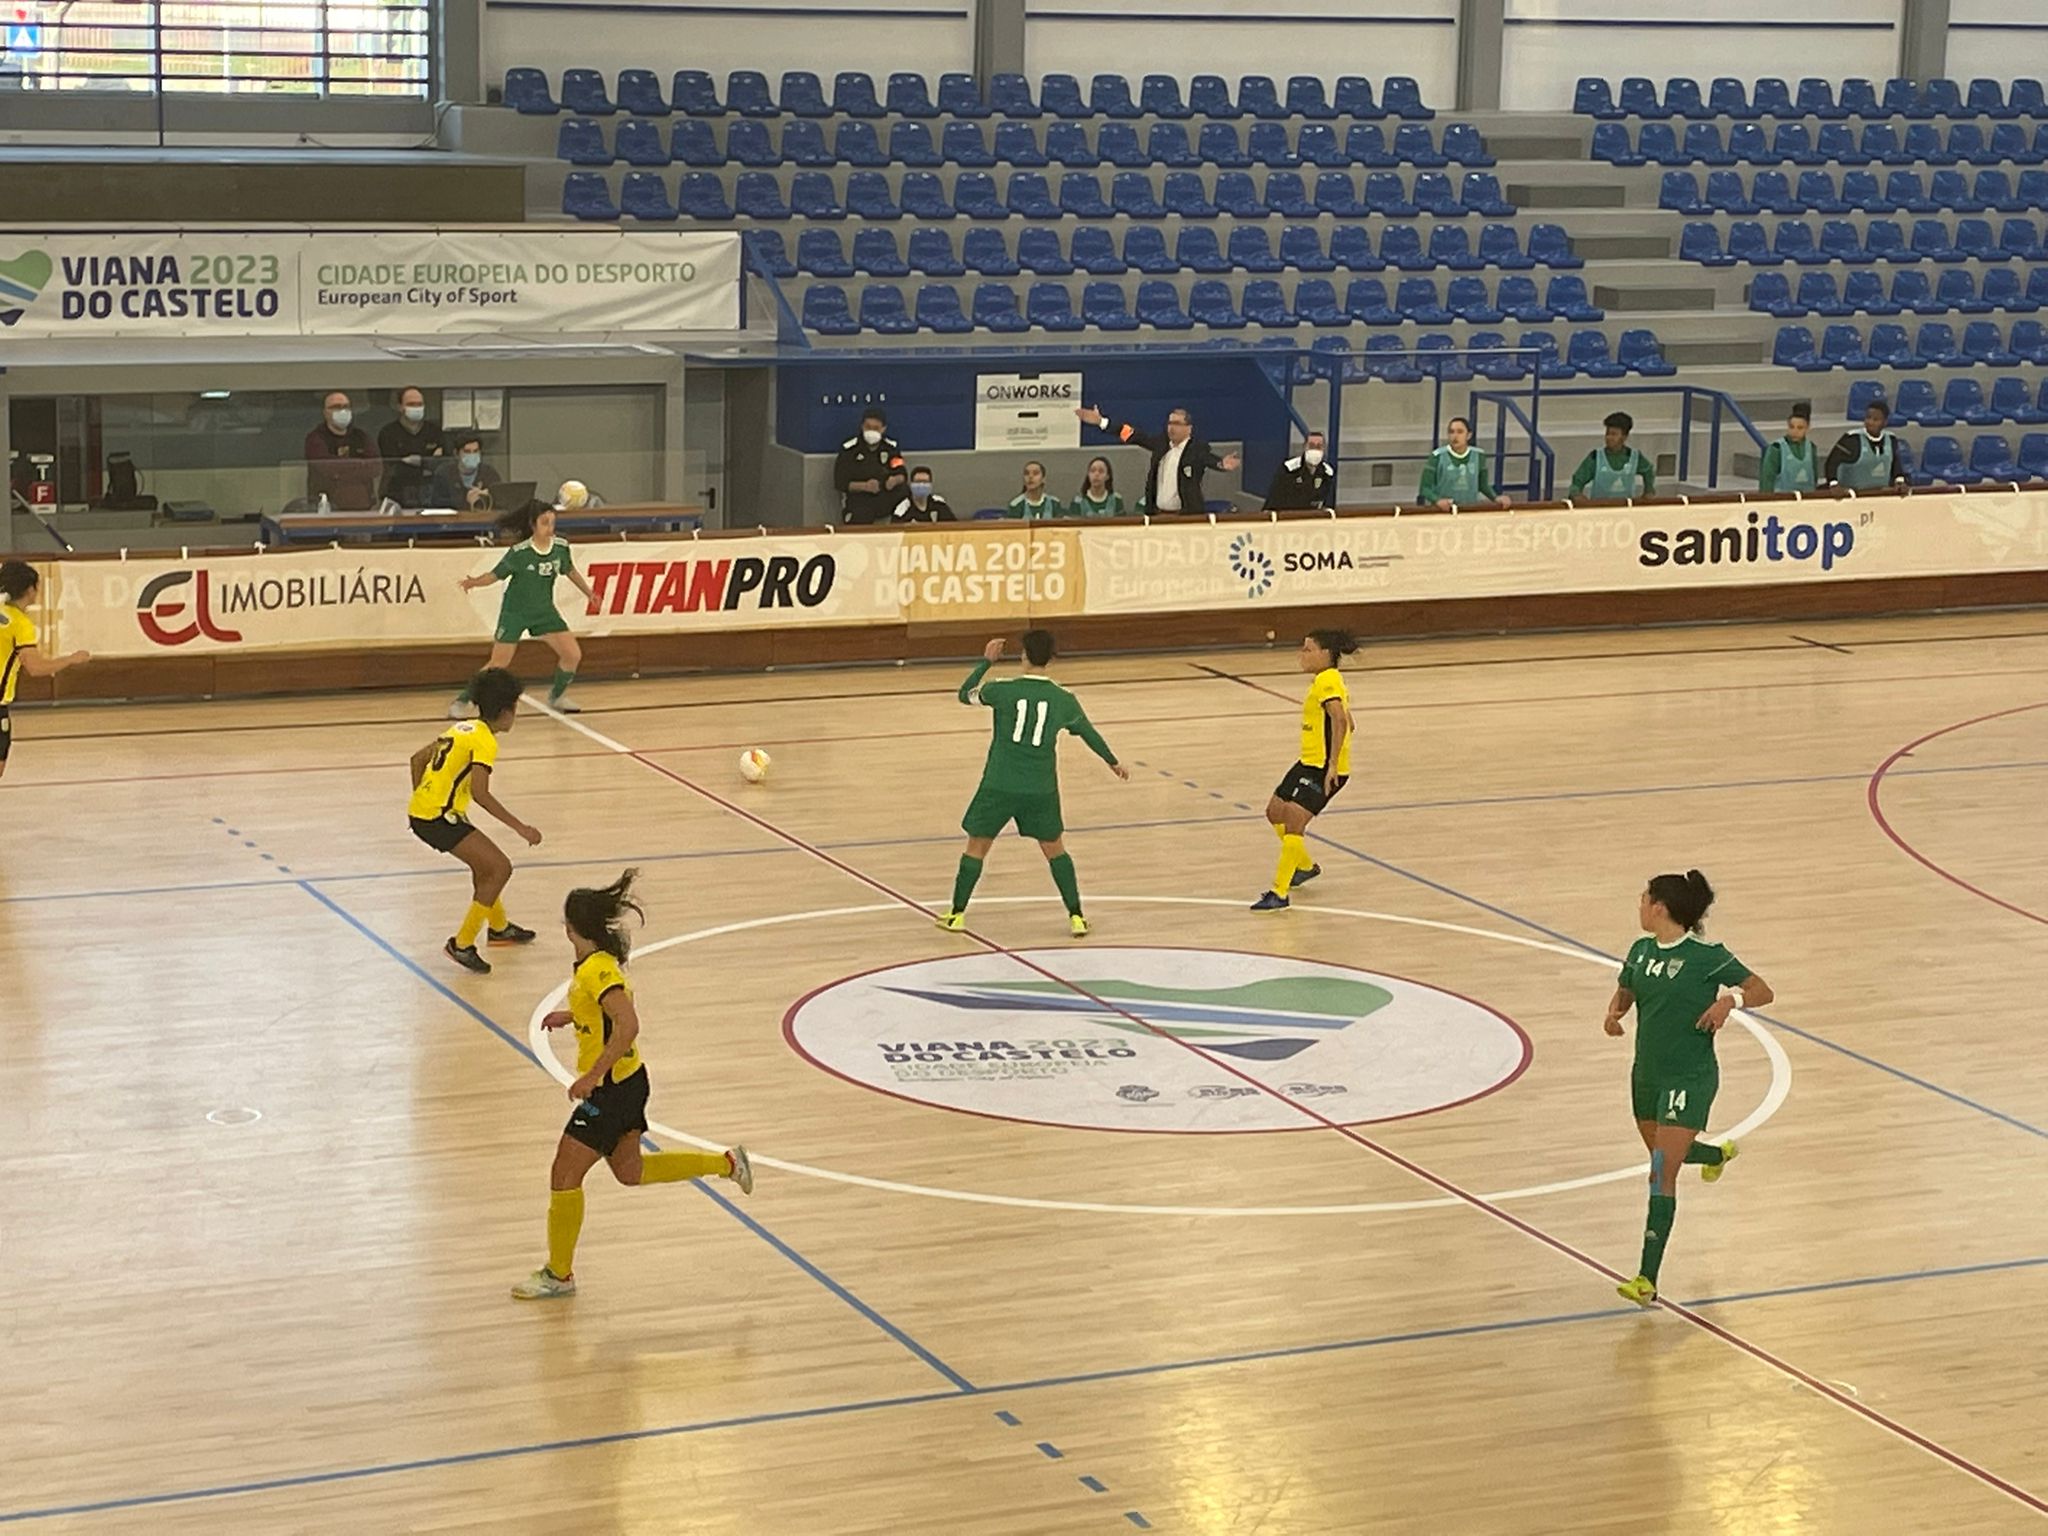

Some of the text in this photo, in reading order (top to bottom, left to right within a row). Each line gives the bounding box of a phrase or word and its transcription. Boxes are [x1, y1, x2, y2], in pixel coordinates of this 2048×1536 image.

[61, 254, 279, 286] VIANA 2023
[317, 262, 696, 285] CIDADE EUROPEIA DO DESPORTO
[61, 288, 279, 319] DO CASTELO
[318, 287, 518, 307] European City of Sport
[987, 384, 1072, 400] ONWORKS
[1473, 518, 1636, 553] DESPORTO
[1639, 512, 1855, 570] sanitop
[876, 541, 1066, 575] VIANA 2023
[1284, 551, 1353, 572] SOMA
[221, 566, 426, 615] IMOBILIÁRIA
[586, 553, 835, 616] TITANPRO
[874, 572, 1066, 607] DO CASTELO
[1012, 699, 1048, 747] 11
[1645, 958, 1665, 977] 14
[877, 1040, 1016, 1052] VIANA
[883, 1048, 1137, 1063] DO CASTELO
[1668, 1088, 1687, 1111] 14
